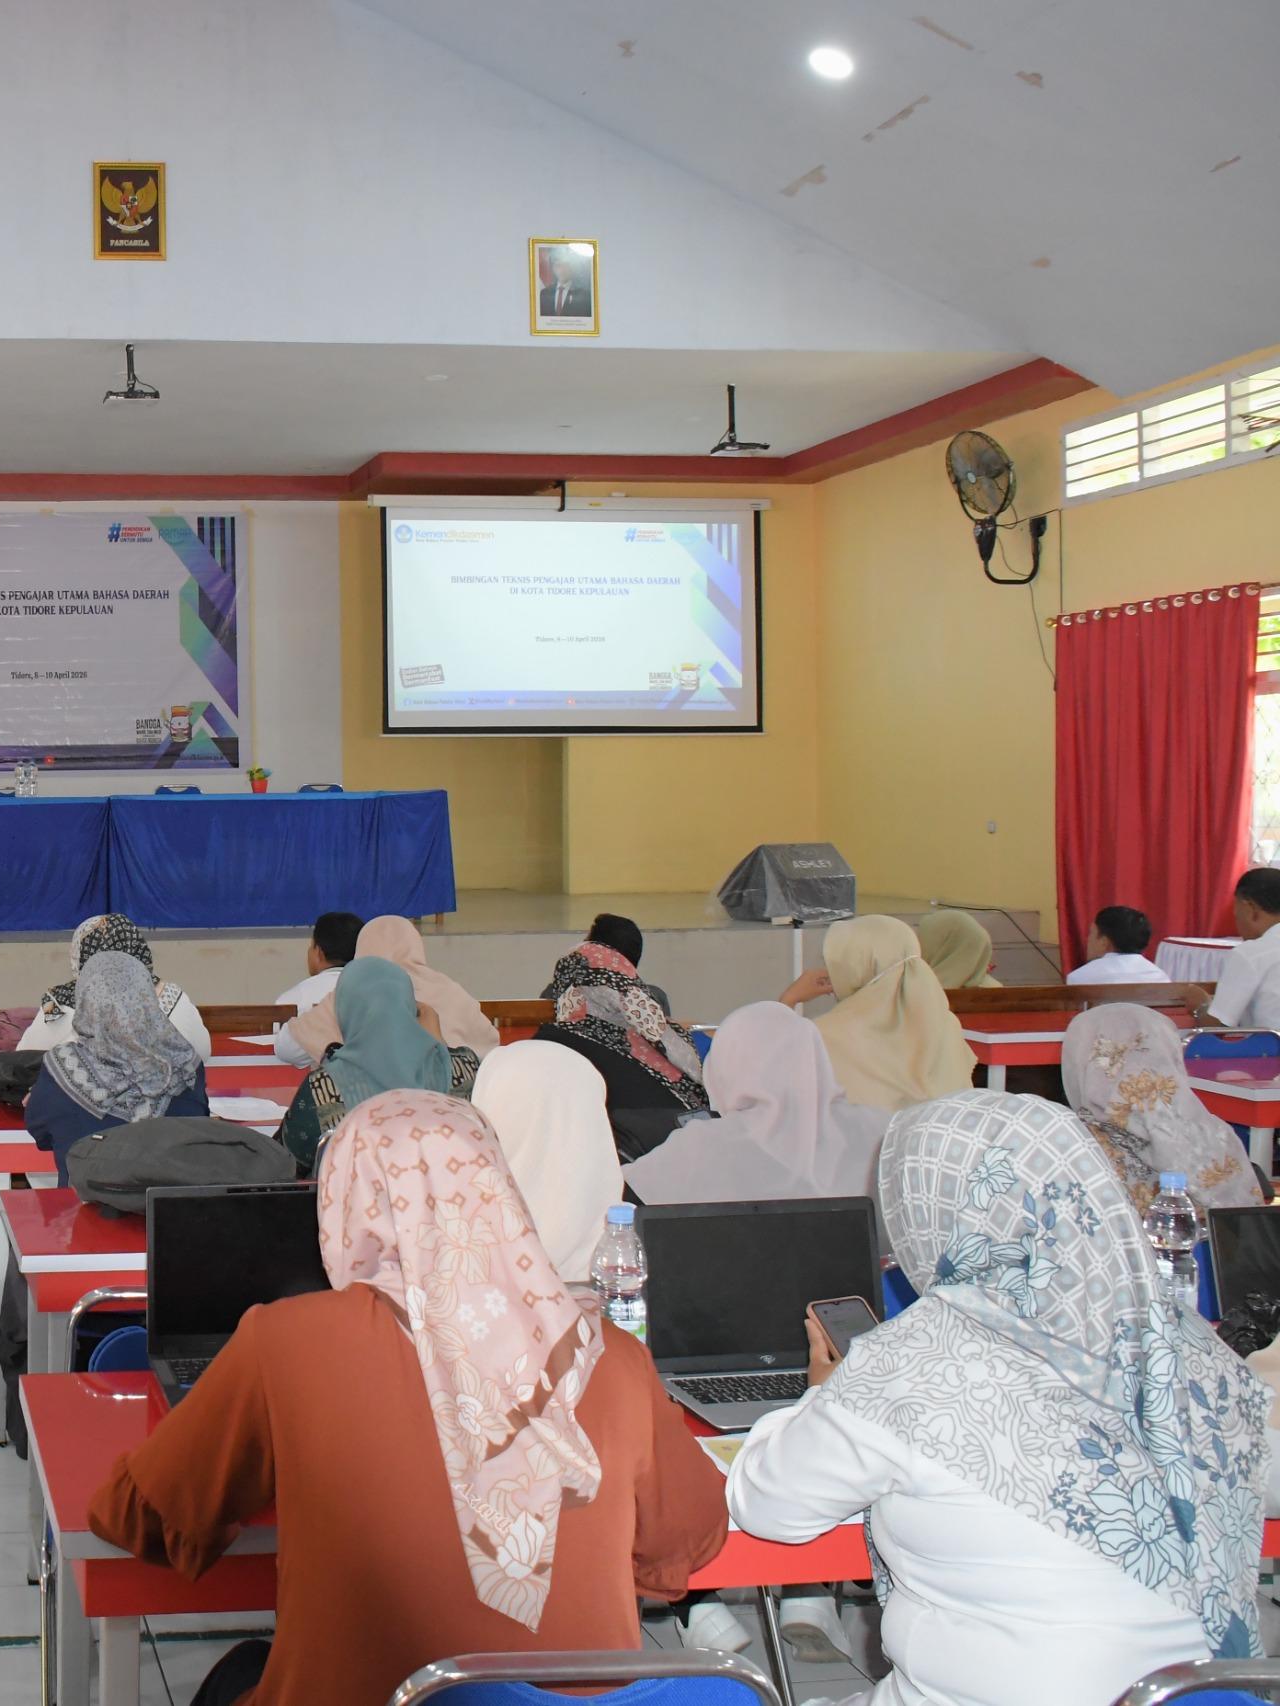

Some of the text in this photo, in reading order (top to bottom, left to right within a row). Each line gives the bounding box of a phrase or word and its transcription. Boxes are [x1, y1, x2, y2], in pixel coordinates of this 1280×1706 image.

[110, 239, 150, 247] PANCASILA
[450, 575, 681, 585] BIMBINGAN TEKNIS PENGAJAR UTAMA BAHASA DAERAH
[8, 590, 54, 602] PENGAJAR
[57, 590, 90, 600] UTAMA
[93, 590, 130, 600] BAHASA
[132, 589, 170, 599] DAERAH
[509, 587, 630, 596] DI KOTA TIDORE KEPULAUAN
[23, 605, 56, 615] TIDORE
[58, 604, 114, 615] KEPULAUAN
[45, 671, 53, 679] 10
[54, 671, 70, 680] April
[70, 671, 88, 679] 2026
[792, 859, 832, 869] ASHLEY
